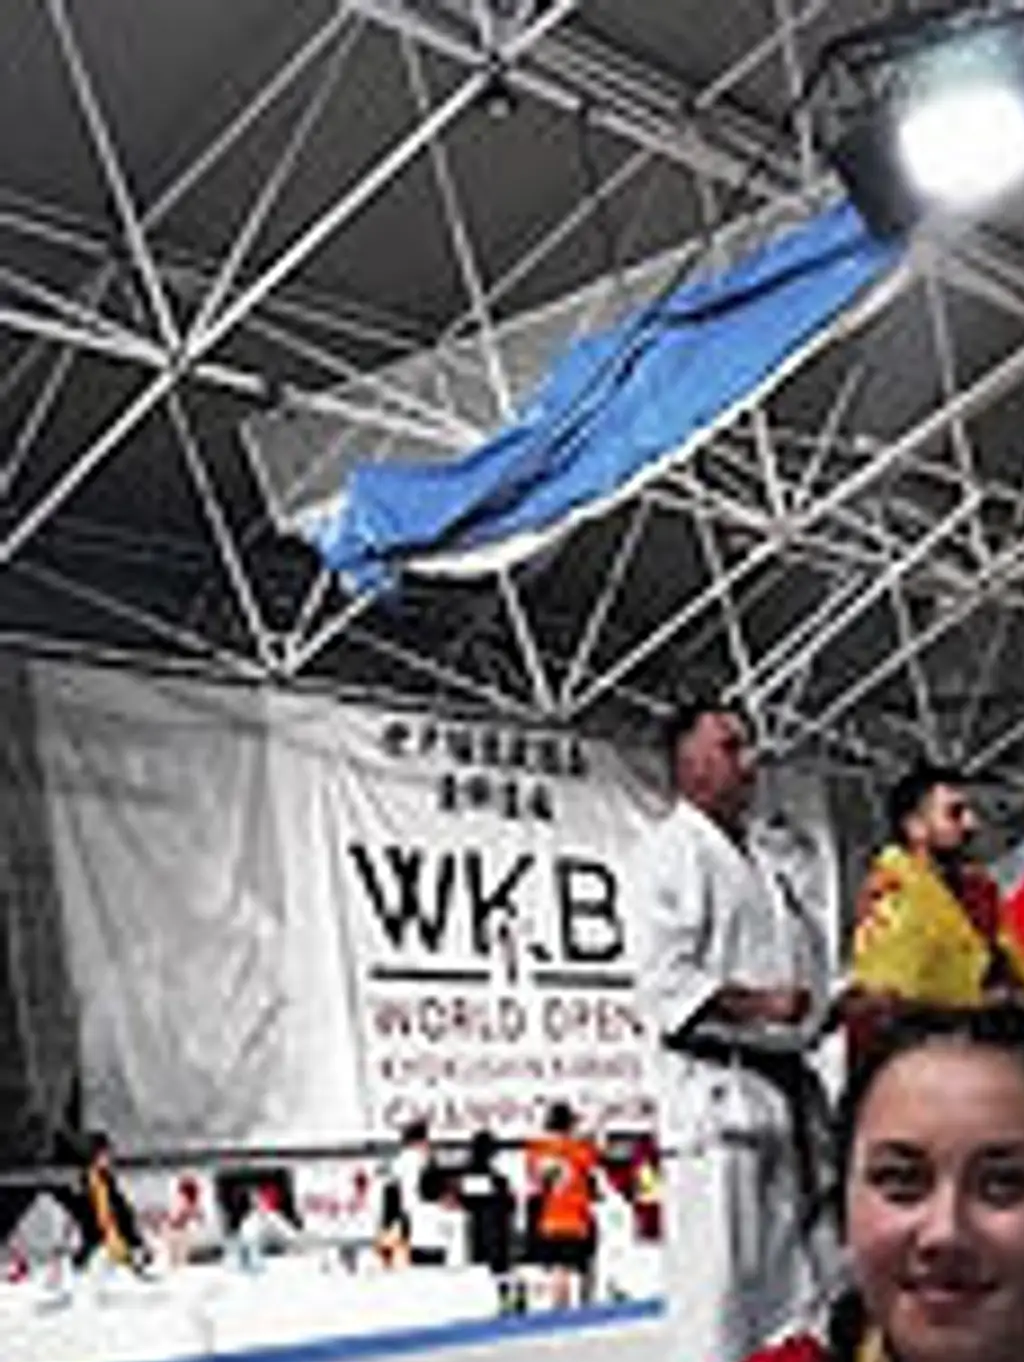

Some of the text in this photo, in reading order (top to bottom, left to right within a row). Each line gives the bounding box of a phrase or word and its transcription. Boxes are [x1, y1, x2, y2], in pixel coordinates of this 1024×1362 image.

[346, 842, 627, 962] WKB
[374, 997, 645, 1043] WORLD OPEN
